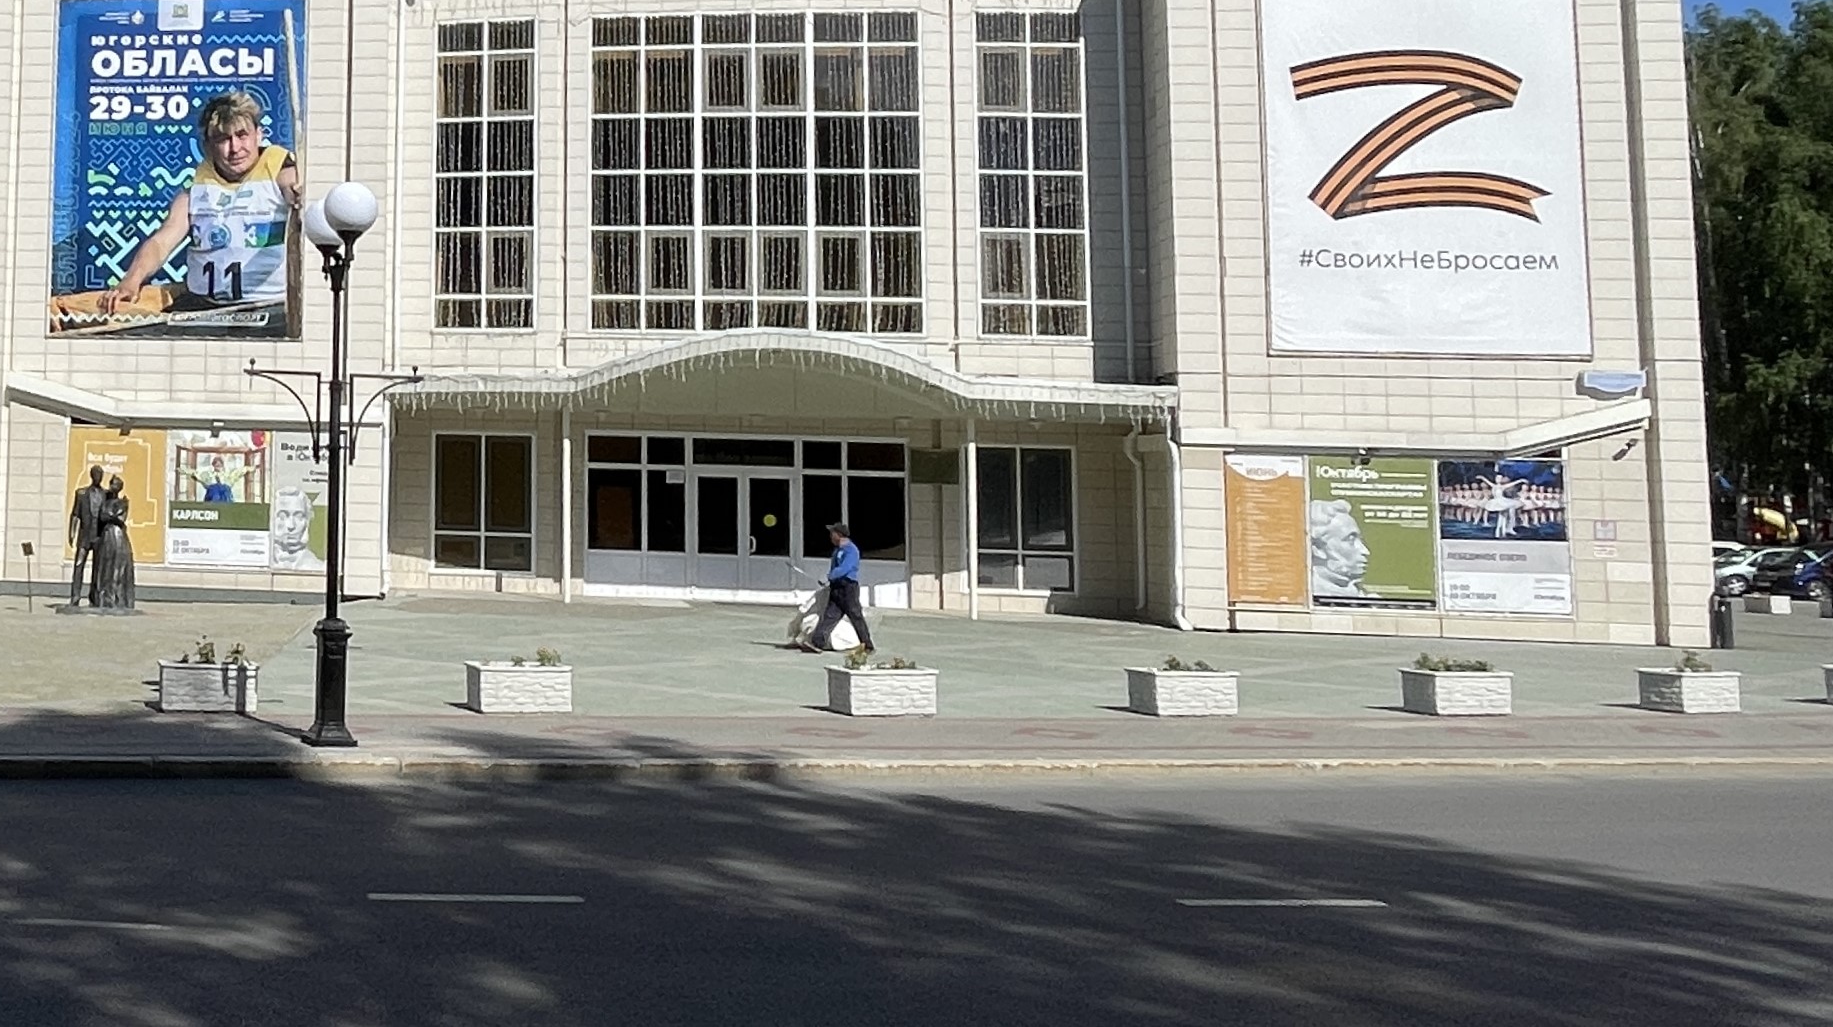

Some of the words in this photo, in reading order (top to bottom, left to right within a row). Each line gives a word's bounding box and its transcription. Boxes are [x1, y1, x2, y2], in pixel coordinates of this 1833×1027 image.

[91, 34, 202, 48] югорские
[91, 48, 275, 77] ОБЛАСЫ
[89, 95, 189, 121] 29-30
[1298, 248, 1559, 273] #СвоихНеБросаем
[202, 261, 243, 300] 11
[172, 509, 219, 521] КАРЛСОН
